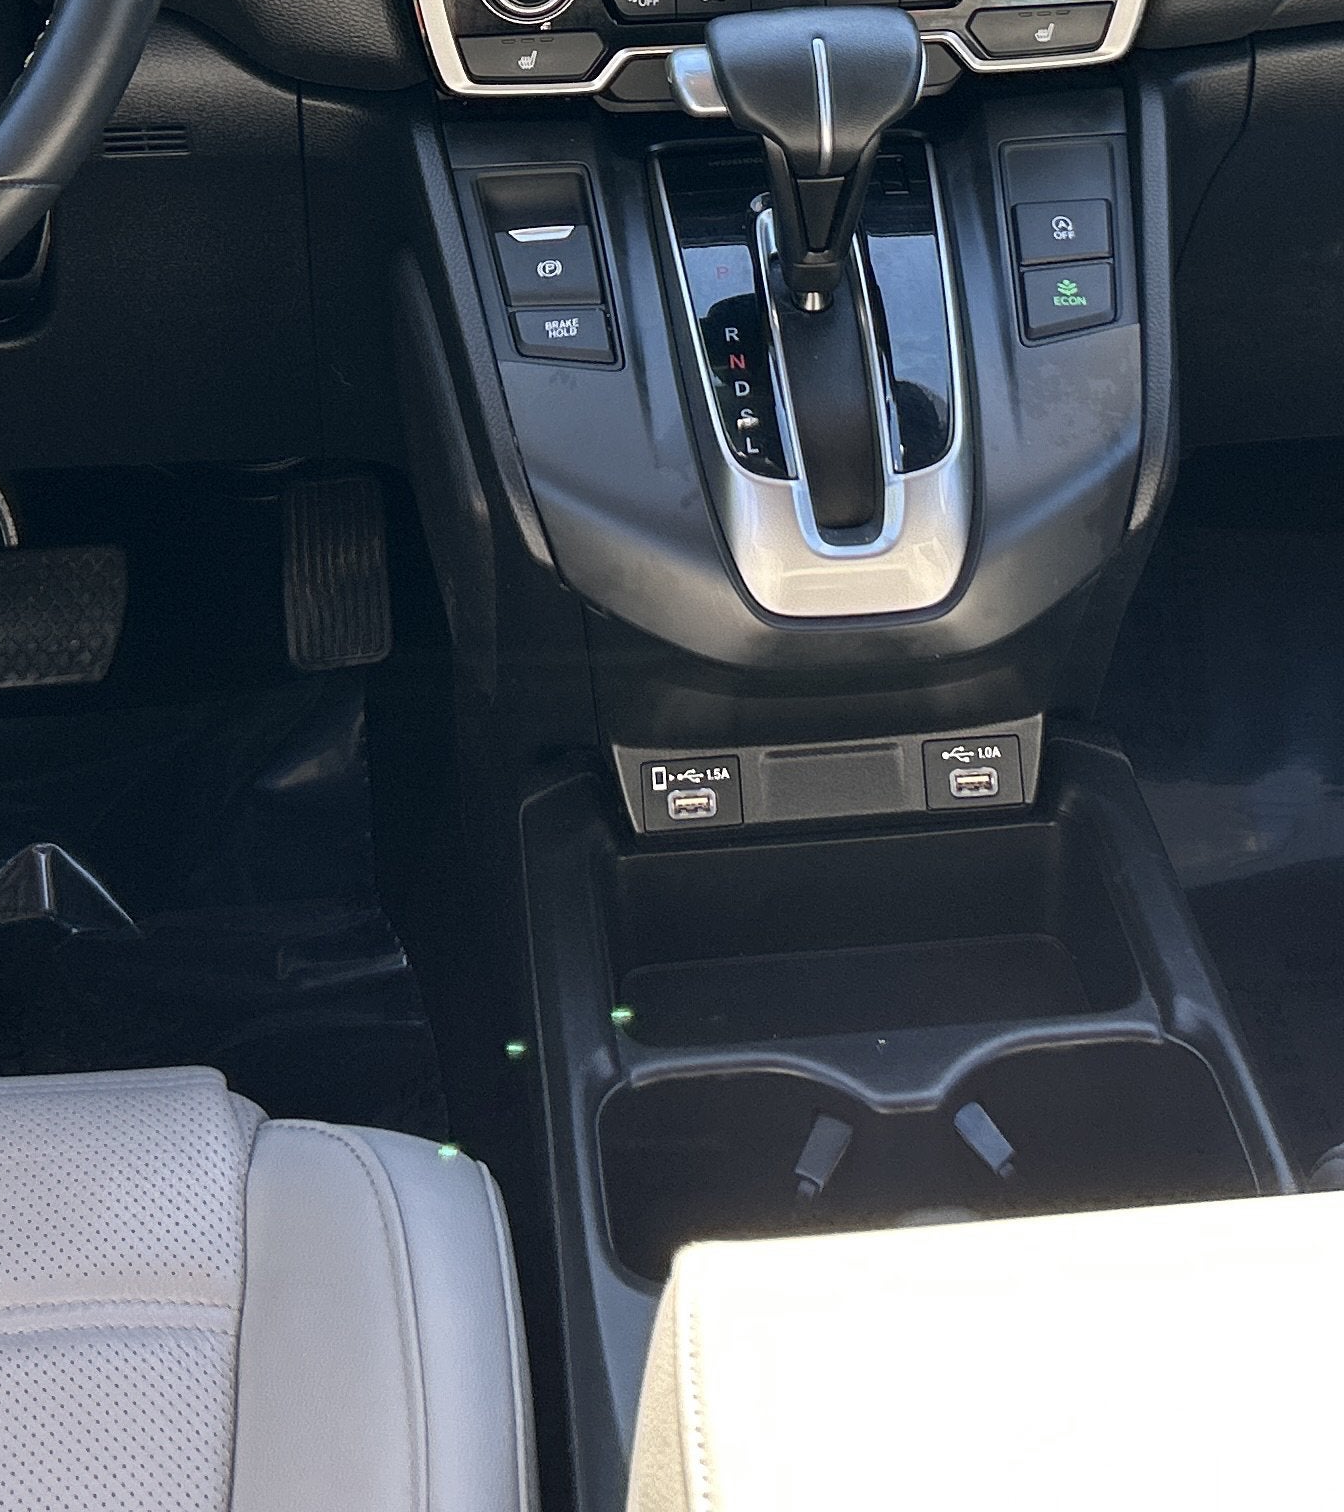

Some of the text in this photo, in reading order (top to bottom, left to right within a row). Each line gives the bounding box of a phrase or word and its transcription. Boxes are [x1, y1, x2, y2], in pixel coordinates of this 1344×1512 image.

[1053, 231, 1075, 240] OFF
[1053, 296, 1087, 306] ECON
[545, 318, 579, 330] BRAKE
[549, 328, 577, 338] HOLD
[724, 327, 740, 342] R
[729, 354, 746, 369] N
[734, 380, 750, 397] D
[746, 437, 760, 454] L
[977, 746, 1002, 760] 1.0A
